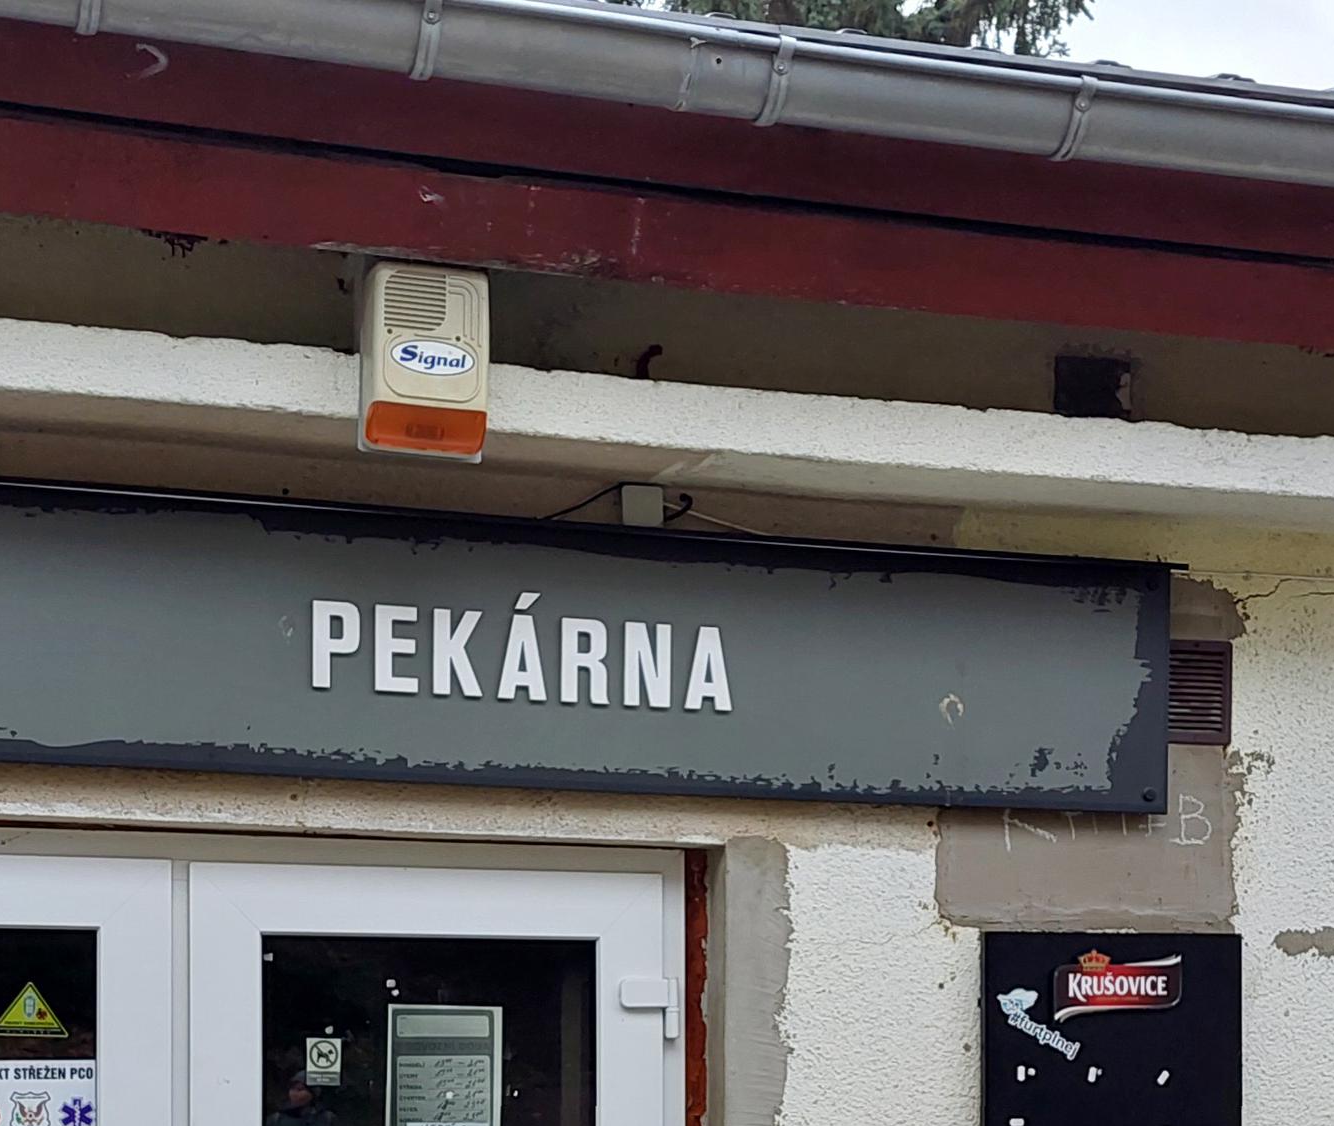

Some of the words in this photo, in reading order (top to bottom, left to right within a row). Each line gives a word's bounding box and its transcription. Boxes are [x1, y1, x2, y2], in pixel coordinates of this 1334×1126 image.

[400, 345, 466, 370] Signal
[311, 591, 733, 713] PEKÁRNA
[1068, 972, 1168, 1003] KRUŠOVICE
[1009, 1011, 1080, 1060] #furtplnej
[13, 1065, 67, 1080] STŘEŽEN
[70, 1067, 94, 1080] PCO
